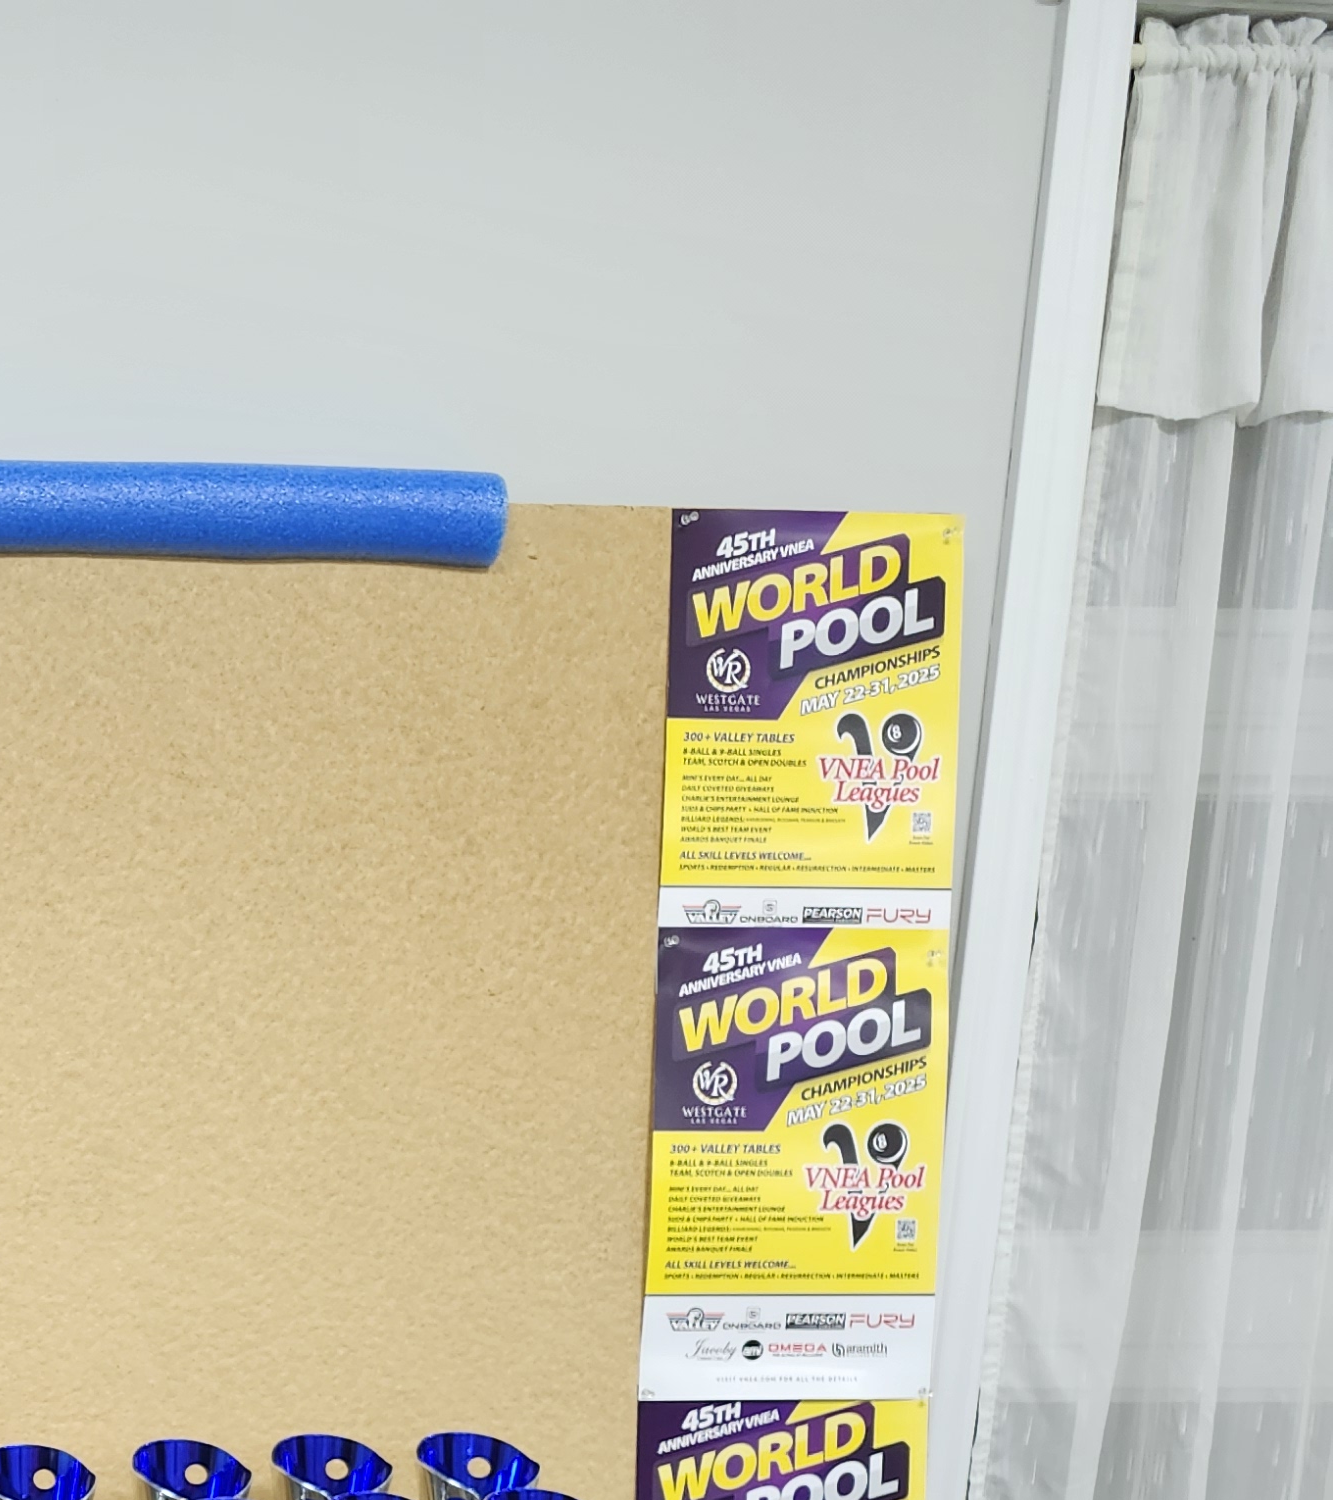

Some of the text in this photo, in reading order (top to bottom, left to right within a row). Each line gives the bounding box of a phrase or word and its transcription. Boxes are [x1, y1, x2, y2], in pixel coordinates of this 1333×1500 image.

[692, 546, 901, 638] WORLD
[779, 587, 935, 669] POOL
[814, 646, 941, 690] CHAMPIONSHIPS
[819, 757, 940, 780] VNEA Pool
[834, 782, 920, 808] Leagues
[678, 959, 888, 1052] WORLD
[766, 1000, 922, 1082] POOL
[801, 1057, 927, 1102] CHAMPIONSHIPS
[806, 1167, 925, 1190] VNEA Pool
[819, 1190, 905, 1218] Leagues
